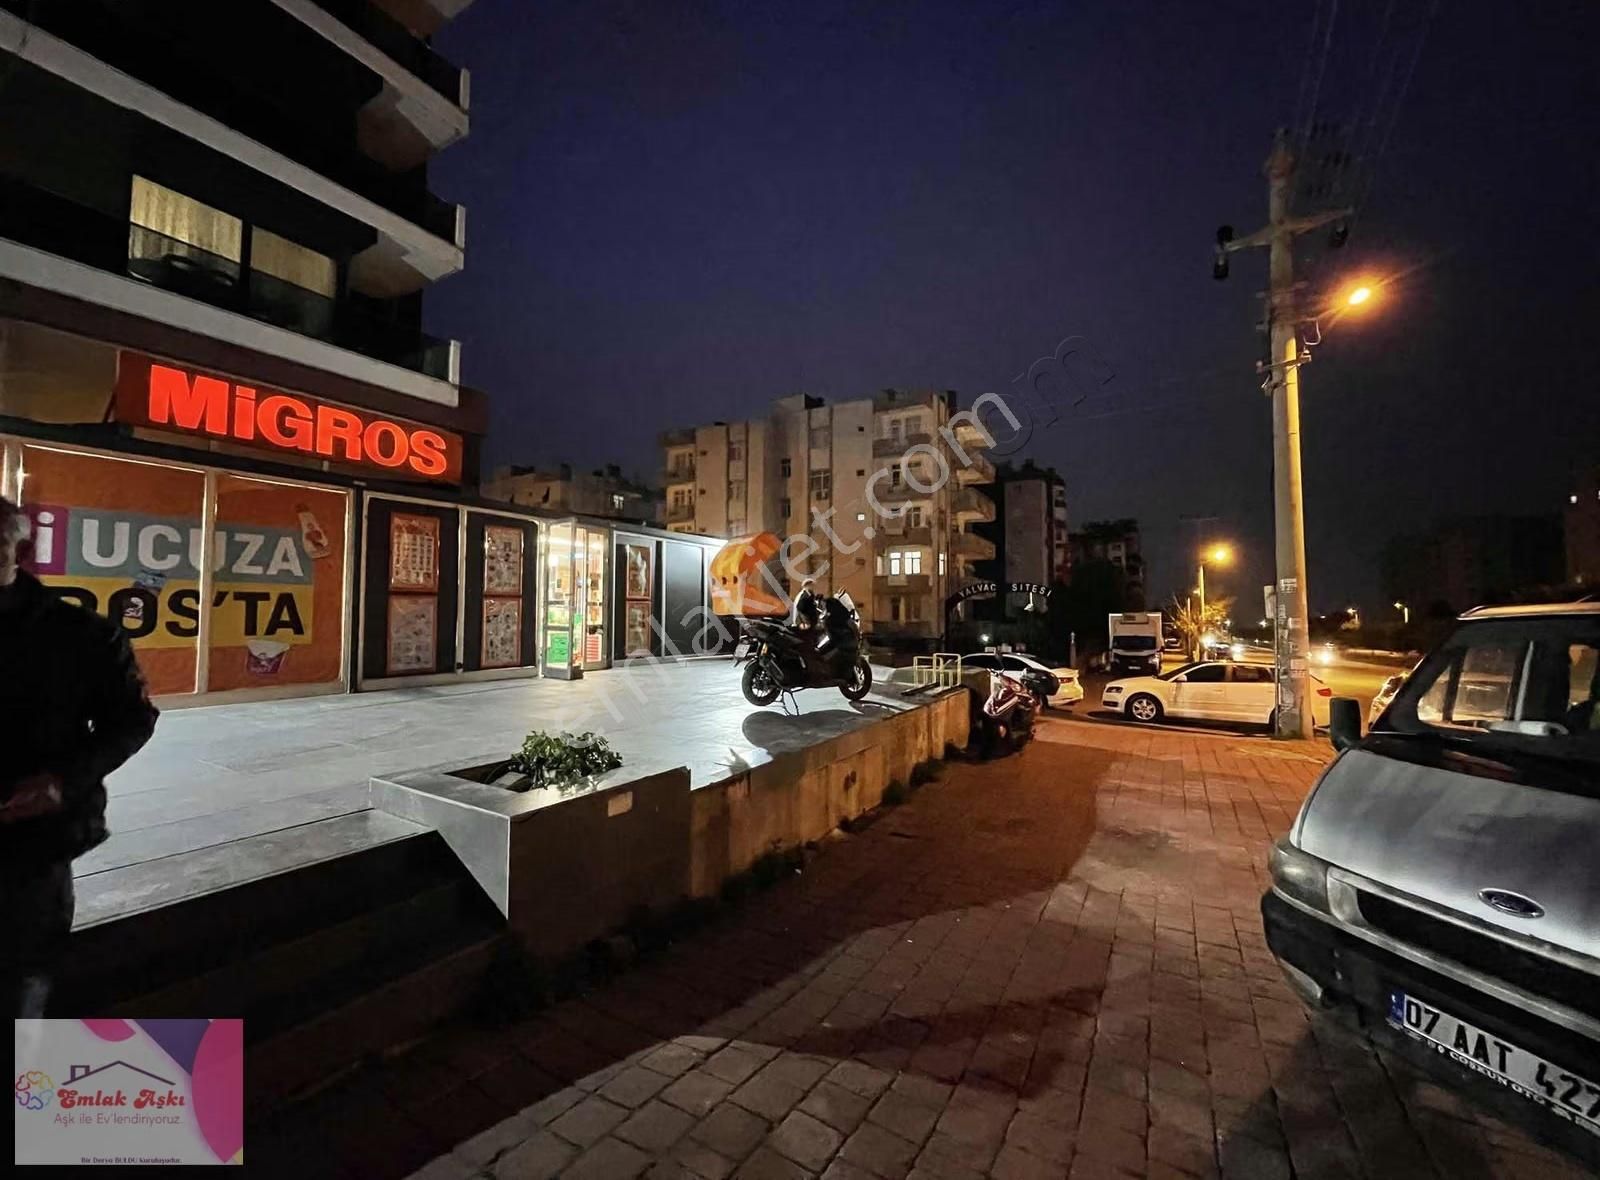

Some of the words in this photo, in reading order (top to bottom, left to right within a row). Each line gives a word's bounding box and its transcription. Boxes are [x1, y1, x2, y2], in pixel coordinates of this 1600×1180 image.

[81, 517, 304, 577] UCUZA
[1405, 1001, 1440, 1035] 07
[1454, 1024, 1513, 1074] AAT
